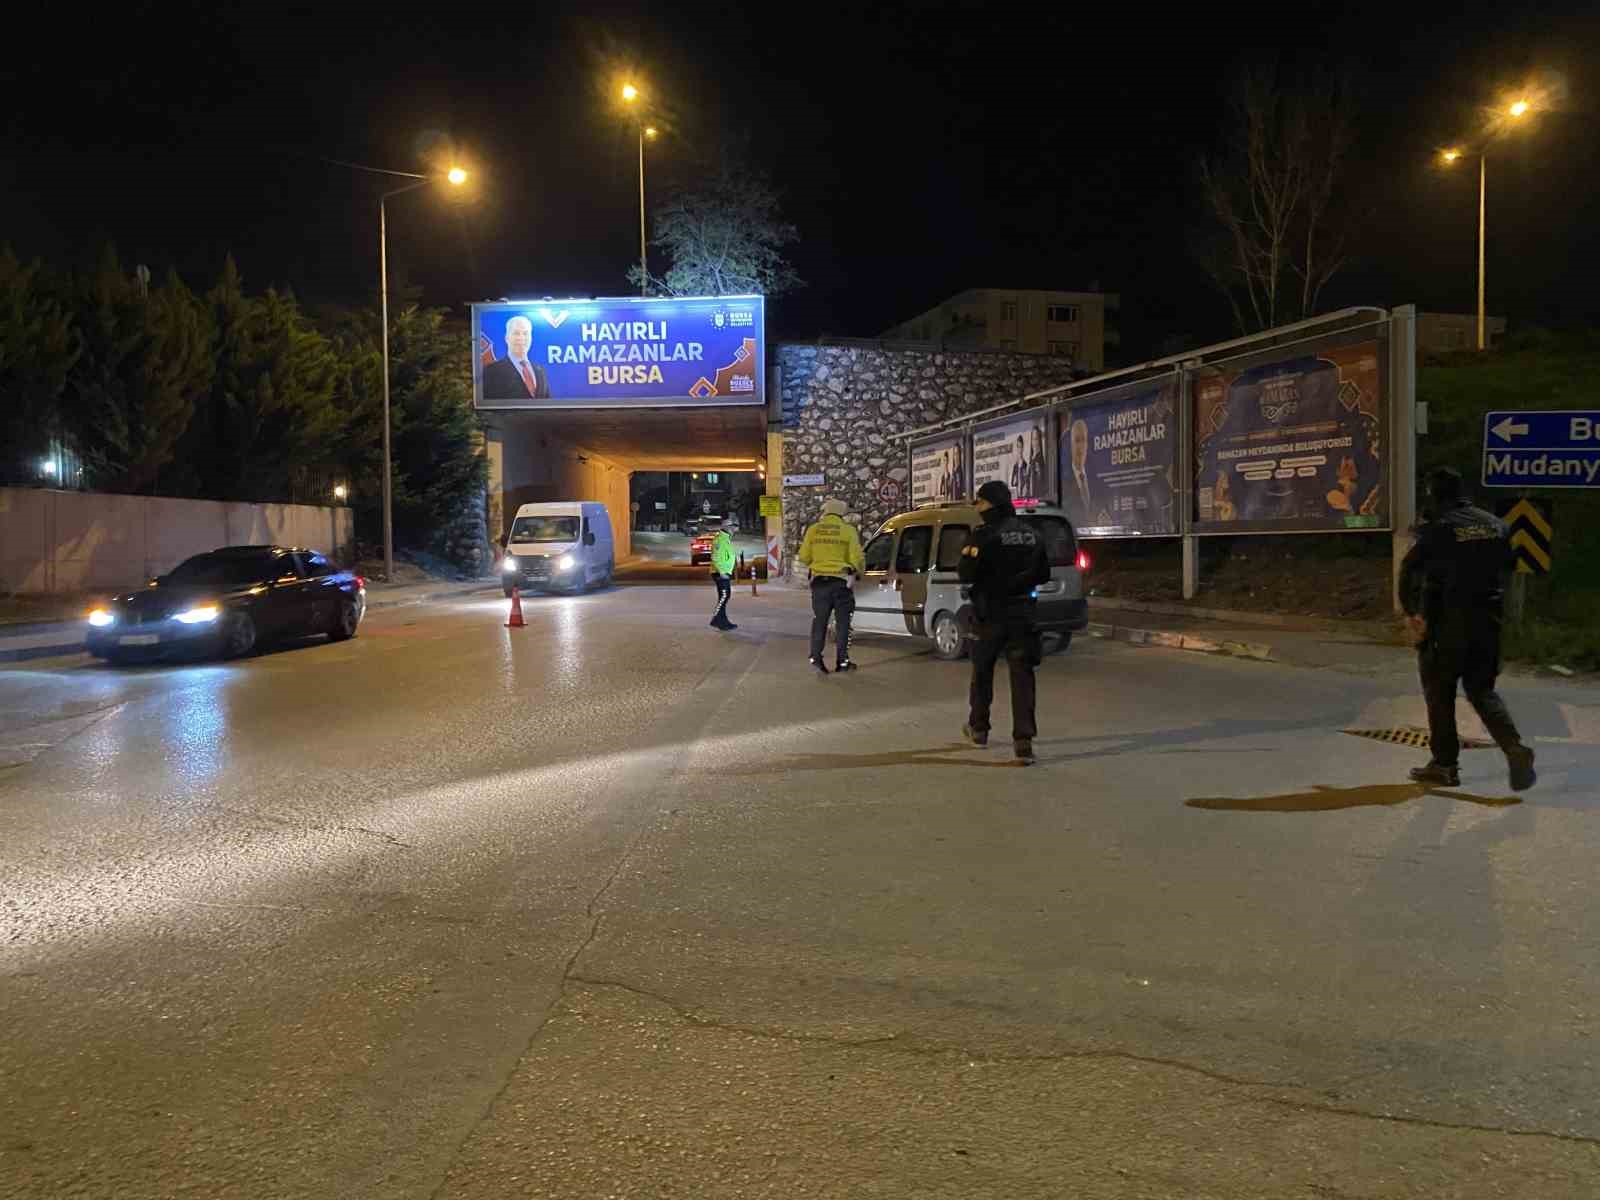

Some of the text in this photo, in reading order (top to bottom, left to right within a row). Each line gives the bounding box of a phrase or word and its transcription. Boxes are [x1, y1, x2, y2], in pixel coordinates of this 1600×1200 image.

[581, 320, 667, 341] HAYIRLI
[547, 342, 704, 364] RAMAZANLAR
[587, 365, 664, 385] BURSA
[1108, 407, 1147, 430] HAYIRLI
[1094, 424, 1165, 451] RAMAZANLAR
[1111, 445, 1146, 465] BURSA
